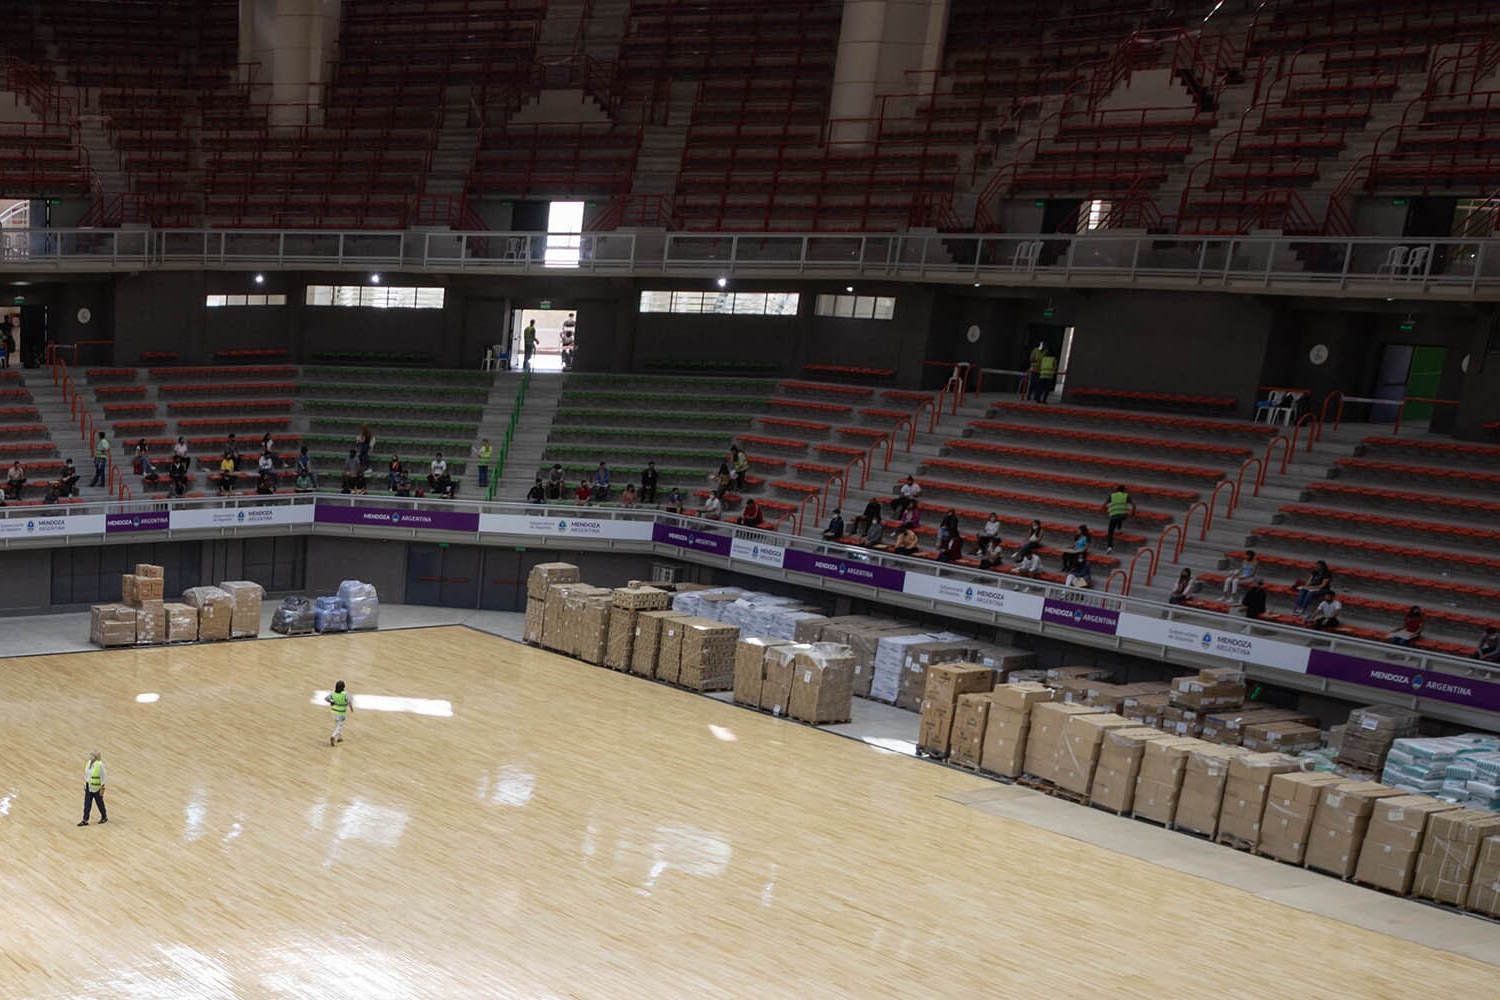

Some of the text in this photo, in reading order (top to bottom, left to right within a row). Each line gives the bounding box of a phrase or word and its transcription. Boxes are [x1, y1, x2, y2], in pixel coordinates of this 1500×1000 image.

[977, 590, 1004, 600] MENDOZA
[1044, 606, 1116, 625] MENDOZA ARGENTINA
[1217, 636, 1252, 648] MENDOZA
[1217, 644, 1250, 655] ARGENTINA
[1370, 670, 1472, 696] MENDOZA ARGENTINA
